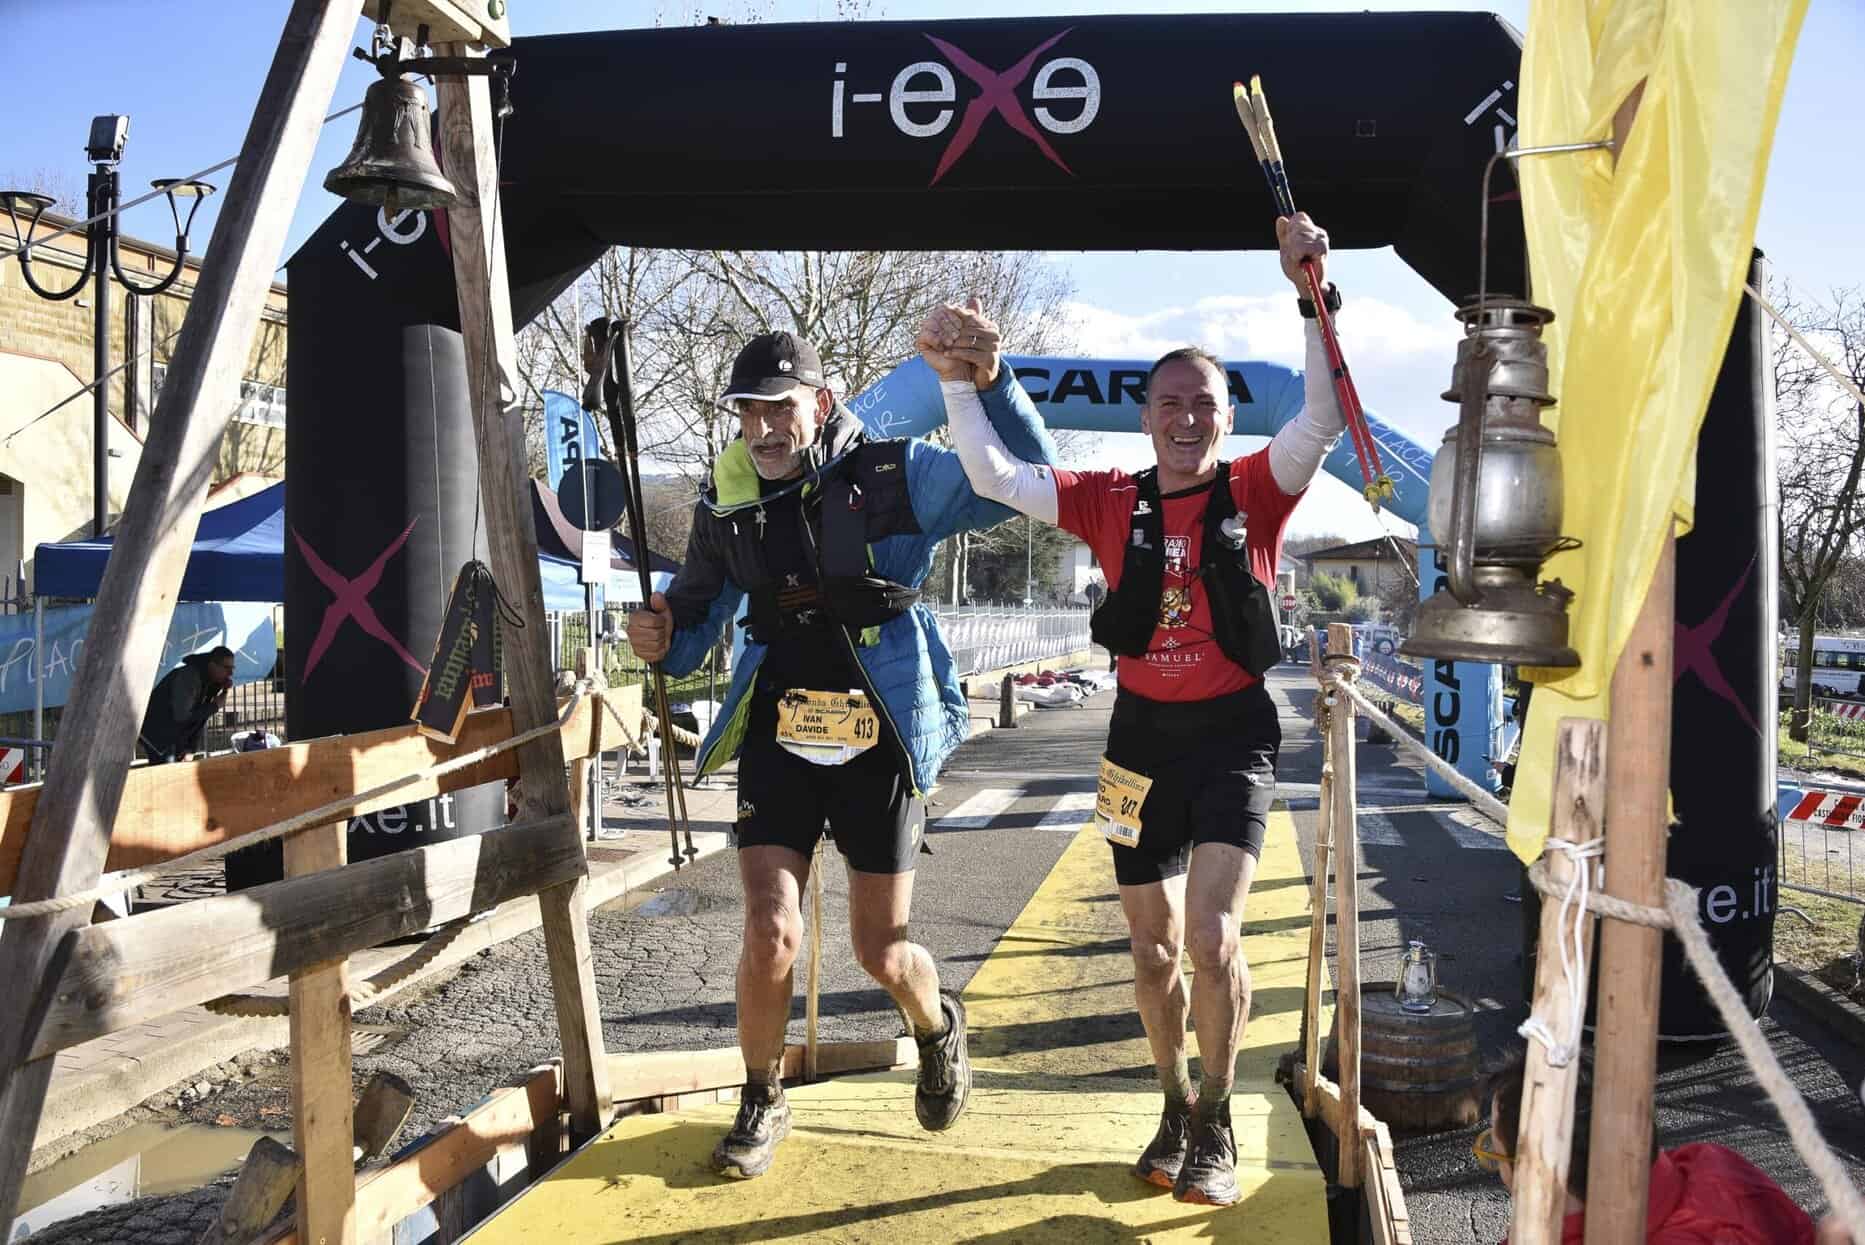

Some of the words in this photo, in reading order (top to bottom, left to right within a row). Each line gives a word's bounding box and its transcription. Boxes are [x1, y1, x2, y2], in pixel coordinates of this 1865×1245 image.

[0, 637, 84, 693] PLAC
[795, 724, 829, 734] DAVIDE
[803, 714, 822, 723] IVAN
[854, 718, 874, 739] 413
[1706, 866, 1772, 923] e.it
